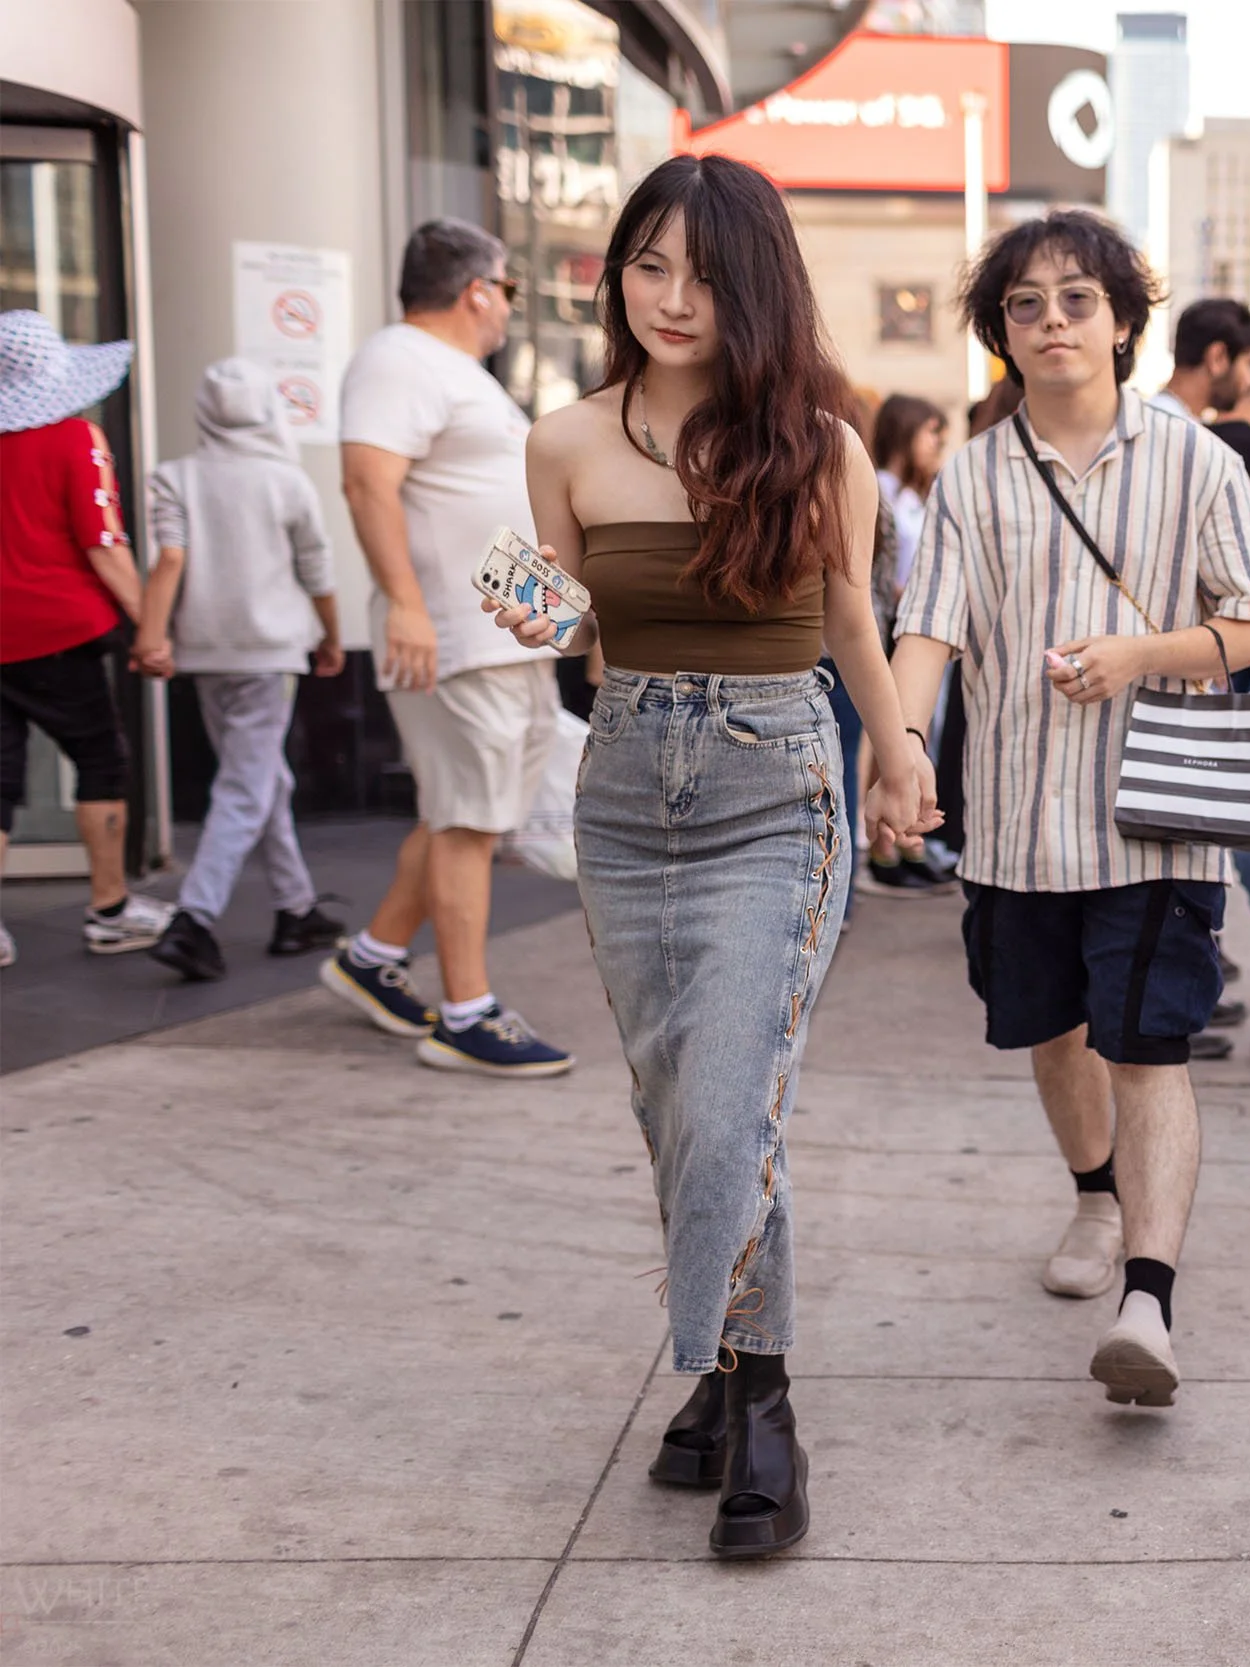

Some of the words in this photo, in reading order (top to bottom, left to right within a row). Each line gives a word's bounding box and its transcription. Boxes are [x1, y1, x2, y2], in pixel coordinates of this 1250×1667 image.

[531, 558, 551, 578] BOSS
[502, 562, 518, 599] SHARK
[1183, 758, 1218, 767] SEPHORA
